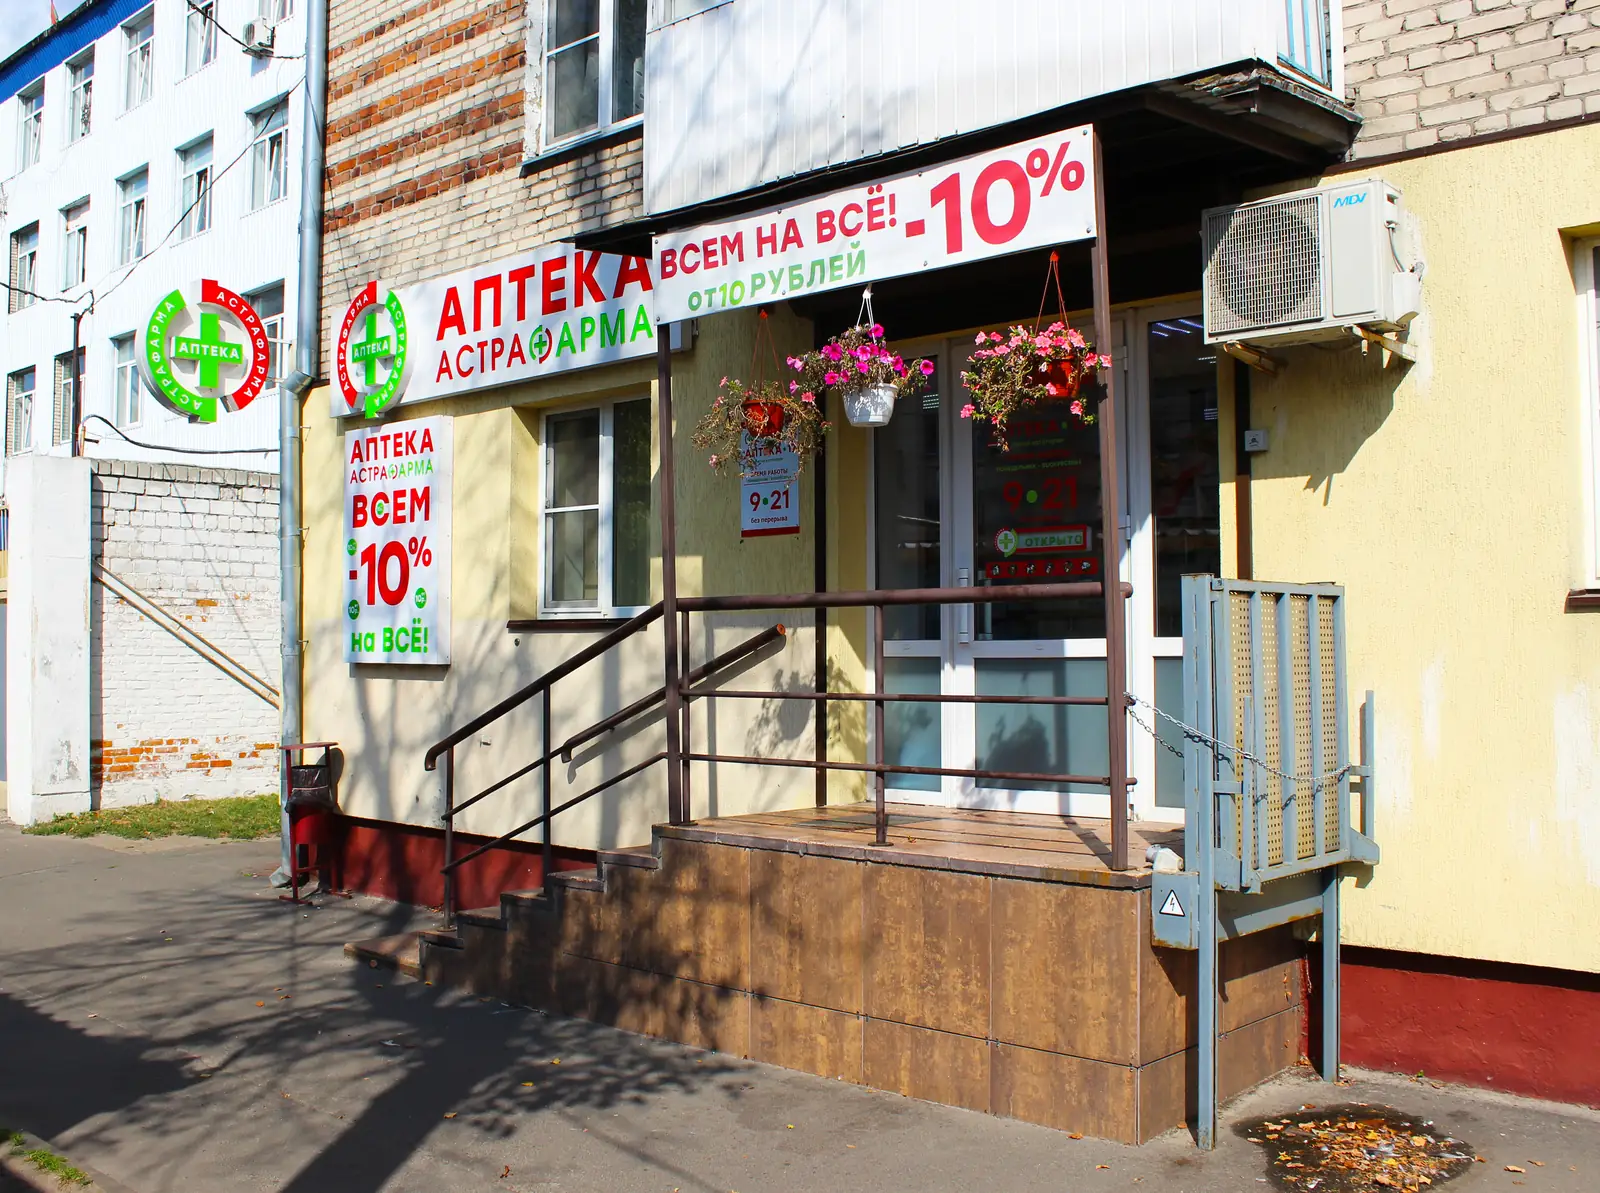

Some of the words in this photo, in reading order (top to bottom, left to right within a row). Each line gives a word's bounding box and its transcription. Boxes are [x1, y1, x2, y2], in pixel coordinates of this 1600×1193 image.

[660, 231, 745, 280] ВСЕМ
[756, 218, 803, 258] НА
[816, 184, 897, 244] ВСЁ!
[904, 140, 1085, 255] -10%
[1333, 191, 1367, 208] MDV
[436, 249, 654, 341] АПТЕКА
[750, 241, 867, 300] РУБЛЕЙ
[151, 300, 203, 411] АСТРАФАРМА
[178, 341, 241, 360] АПТЕКА
[217, 290, 267, 399] АСТРАФАРМА
[338, 293, 370, 392] АСТРАФАРМА
[352, 340, 390, 358] АПТЕКА
[373, 300, 405, 408] АСТРАФАРМА
[350, 428, 434, 464] АПТЕКА
[352, 486, 431, 529] ВСЕМ
[1025, 534, 1083, 548] ОТКРЫТО
[348, 536, 433, 606] -10%
[382, 617, 429, 654] ВСЁ!
